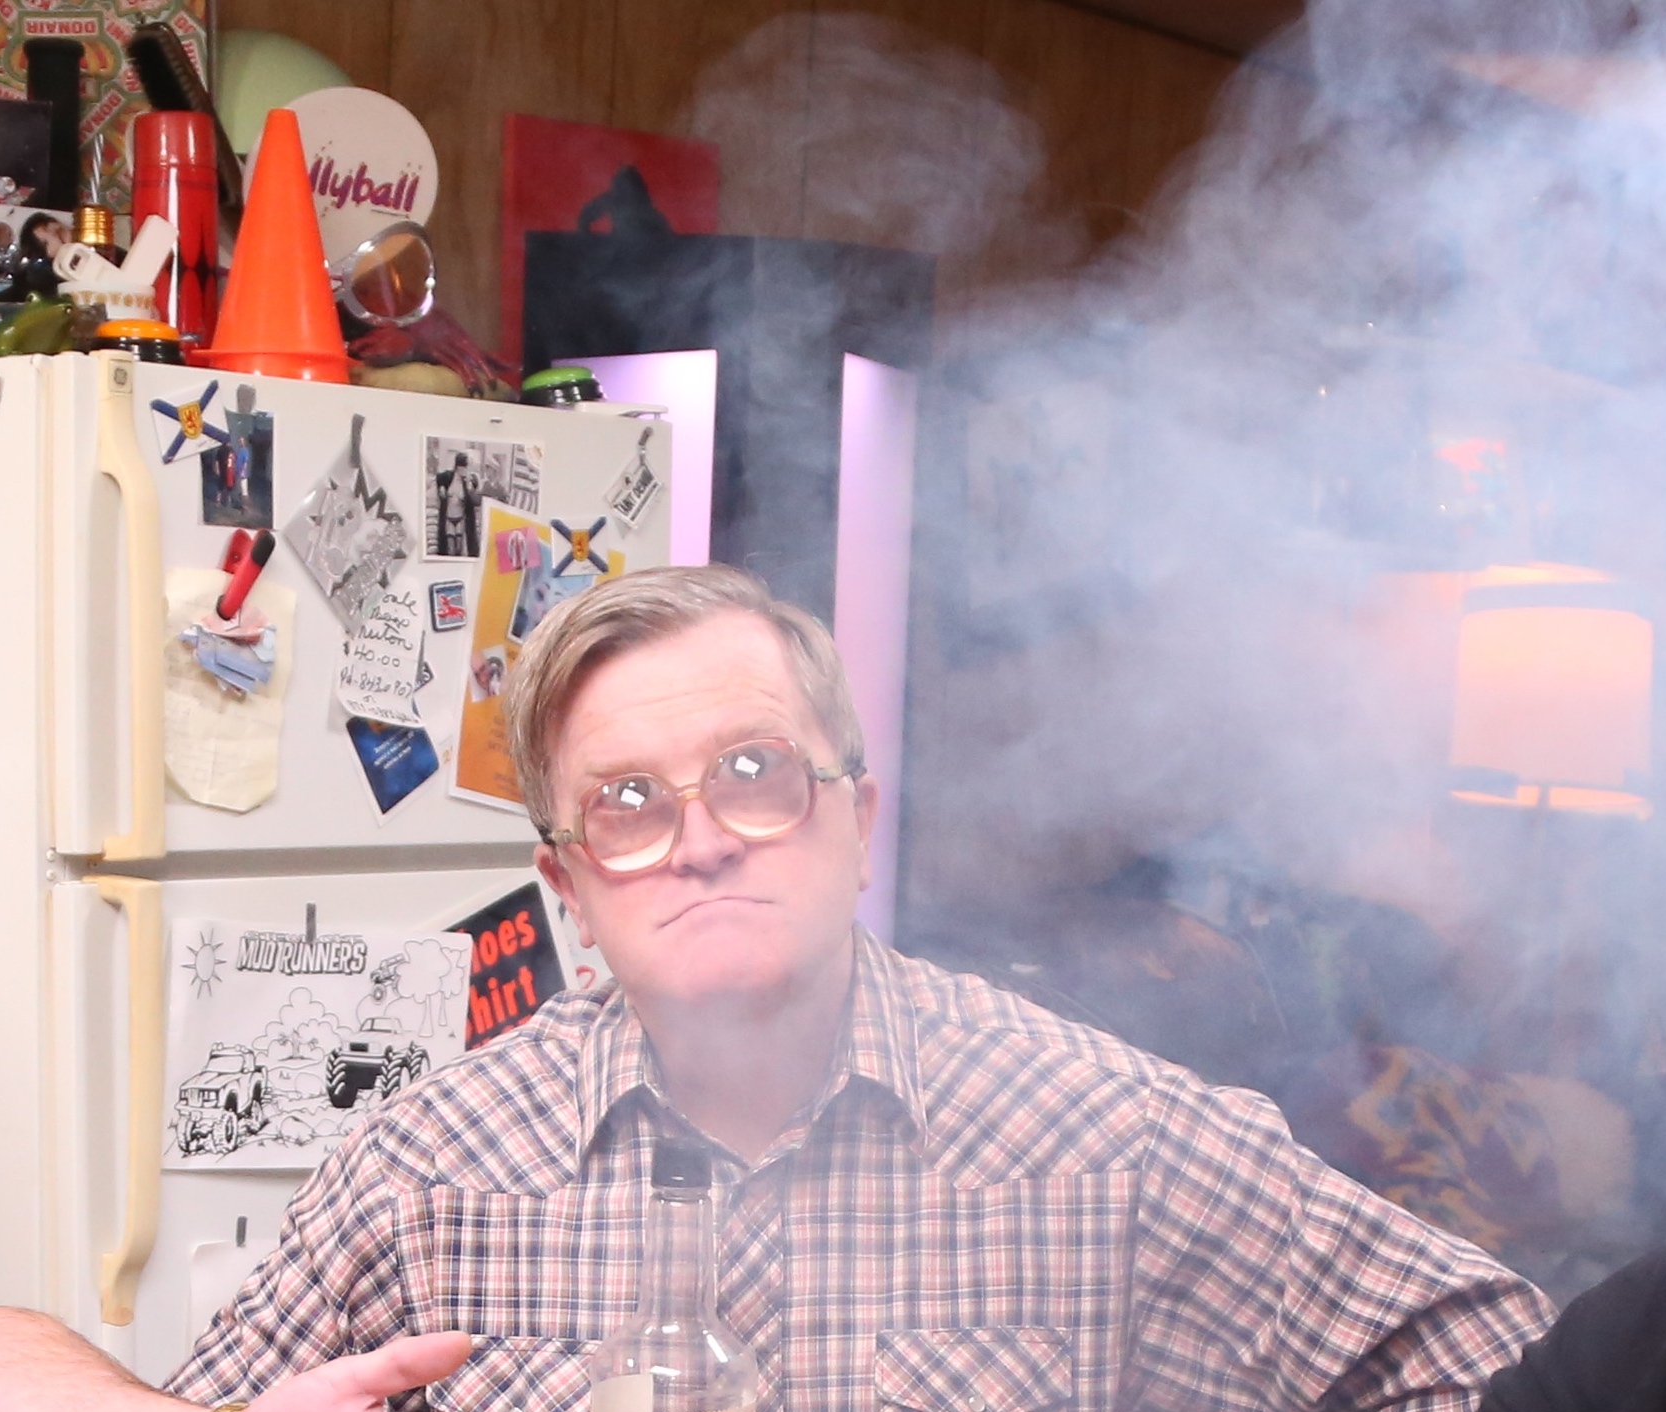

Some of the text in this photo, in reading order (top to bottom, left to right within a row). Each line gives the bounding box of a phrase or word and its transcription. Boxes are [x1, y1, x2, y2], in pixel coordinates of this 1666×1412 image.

[24, 17, 99, 35] DONAIR
[308, 156, 421, 213] llyball
[472, 910, 536, 976] oes
[467, 965, 538, 1043] hirt
